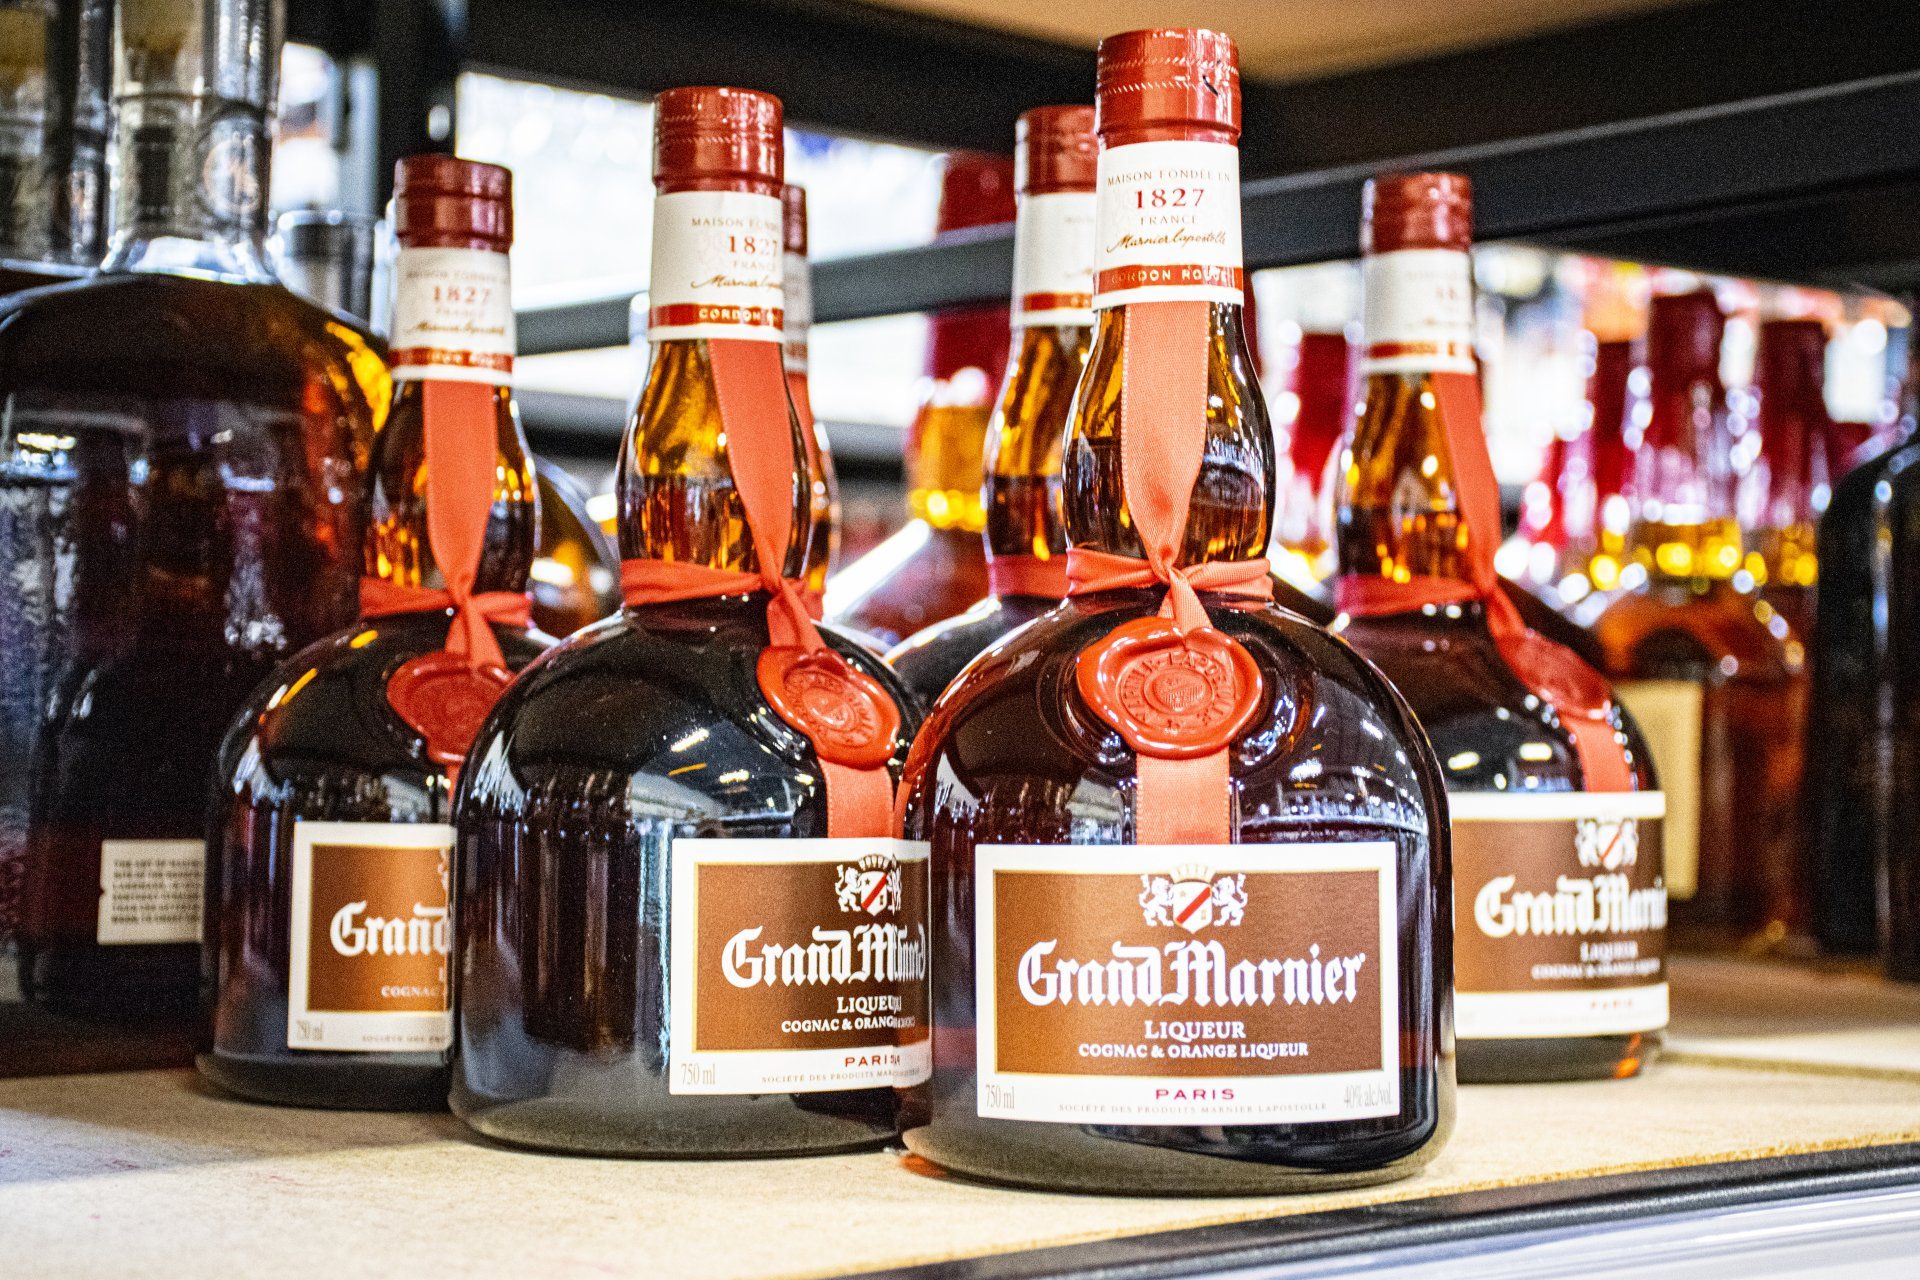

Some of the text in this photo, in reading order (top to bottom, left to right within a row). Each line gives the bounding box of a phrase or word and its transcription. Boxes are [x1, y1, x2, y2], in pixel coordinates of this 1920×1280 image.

[1107, 171, 1152, 187] MAISON
[1136, 188, 1204, 209] 1827
[1140, 215, 1196, 226] FRANCE
[729, 235, 777, 256] 1827
[698, 308, 761, 322] CORDON
[1474, 874, 1594, 938] Grand
[721, 925, 852, 989] Grand
[1018, 938, 1366, 1007] Grand Marnier
[836, 995, 900, 1014] LIQUEU
[781, 1019, 840, 1033] COGNAC
[841, 1019, 853, 1031] &
[854, 1016, 896, 1031] ORANG
[1144, 1020, 1247, 1043] LIQUEUR
[1078, 1043, 1309, 1060] COGNAC & ORANGE LIQUEUR
[681, 1063, 716, 1085] 750 ml
[985, 1084, 1015, 1109] 750 ml
[1155, 1088, 1235, 1100] PARIS
[1111, 1104, 1133, 1113] DES
[1137, 1104, 1196, 1114] PRODUITS
[1200, 1104, 1253, 1113] MARNIER
